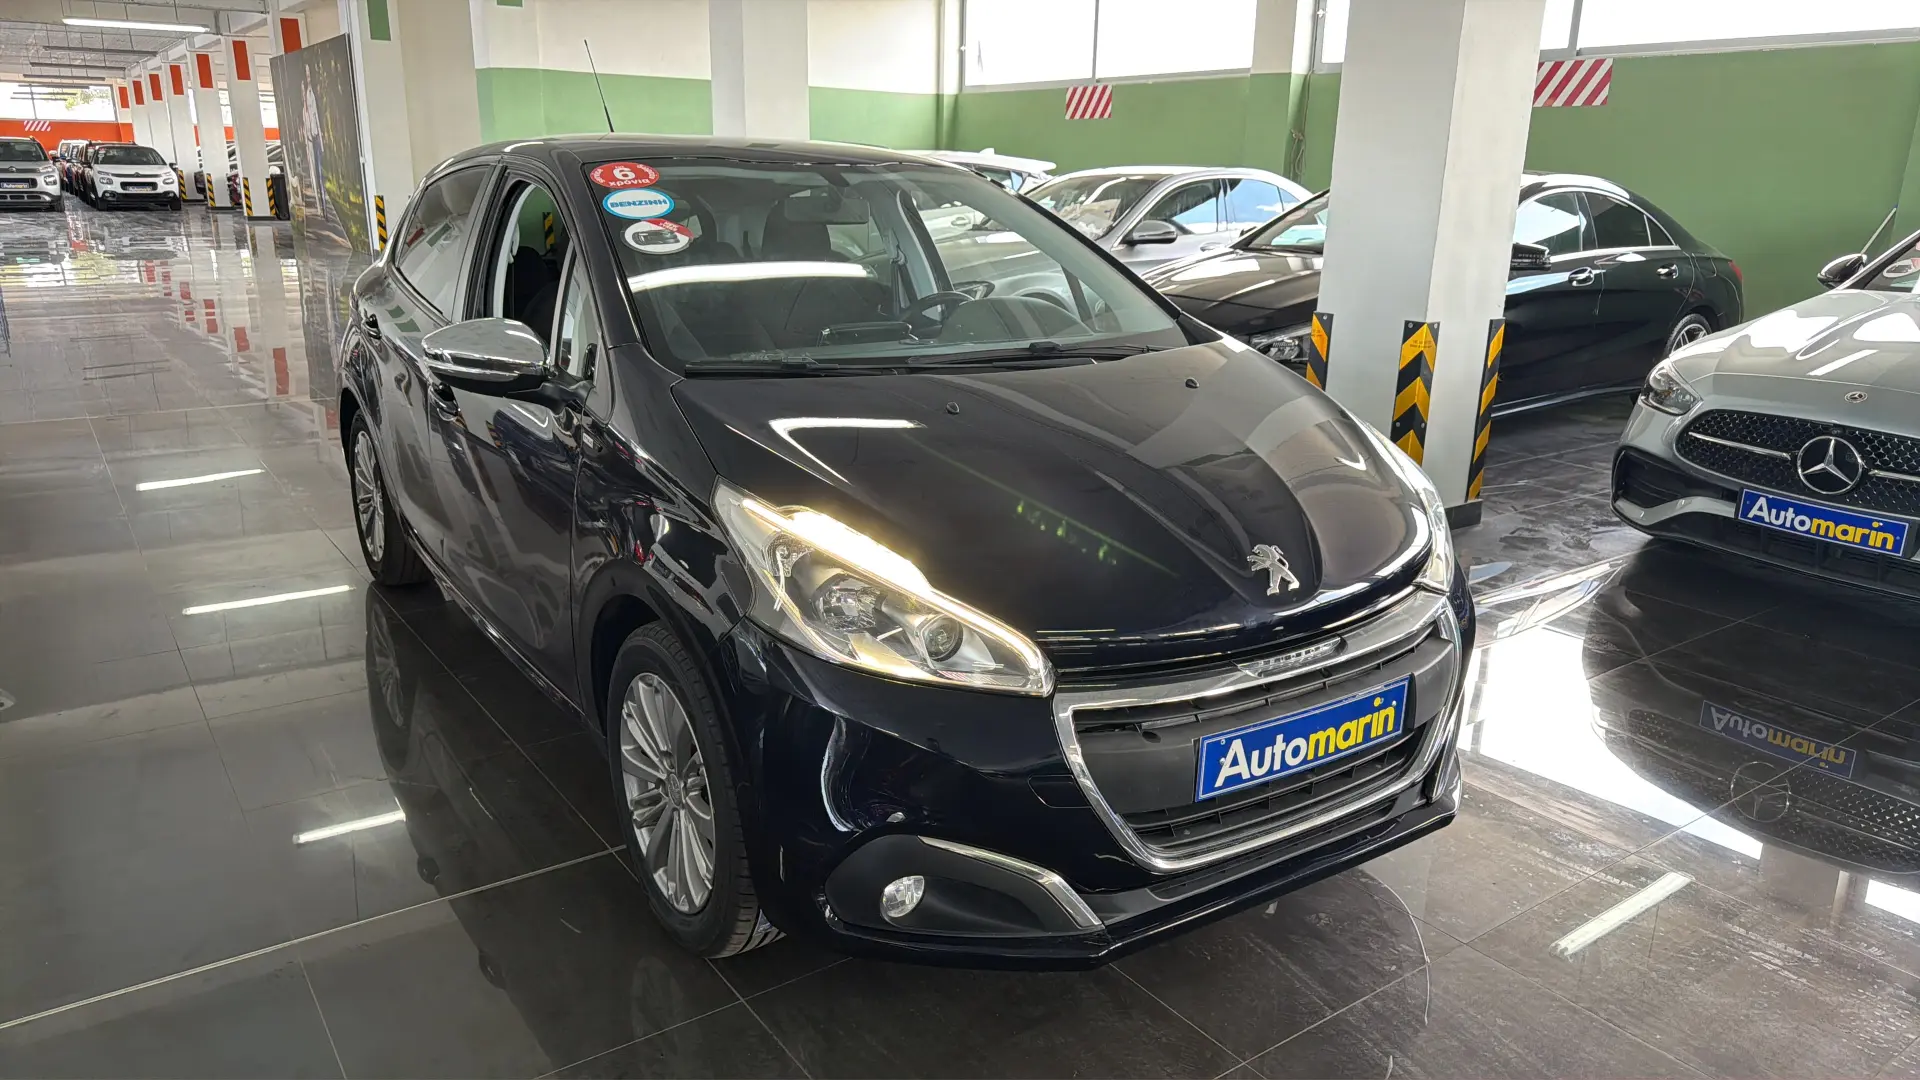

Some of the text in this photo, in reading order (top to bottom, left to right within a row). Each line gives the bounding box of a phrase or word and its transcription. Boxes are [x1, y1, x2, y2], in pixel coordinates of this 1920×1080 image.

[612, 167, 636, 180] 6
[1747, 496, 1895, 550] Automarin
[1214, 696, 1396, 788] Automarin
